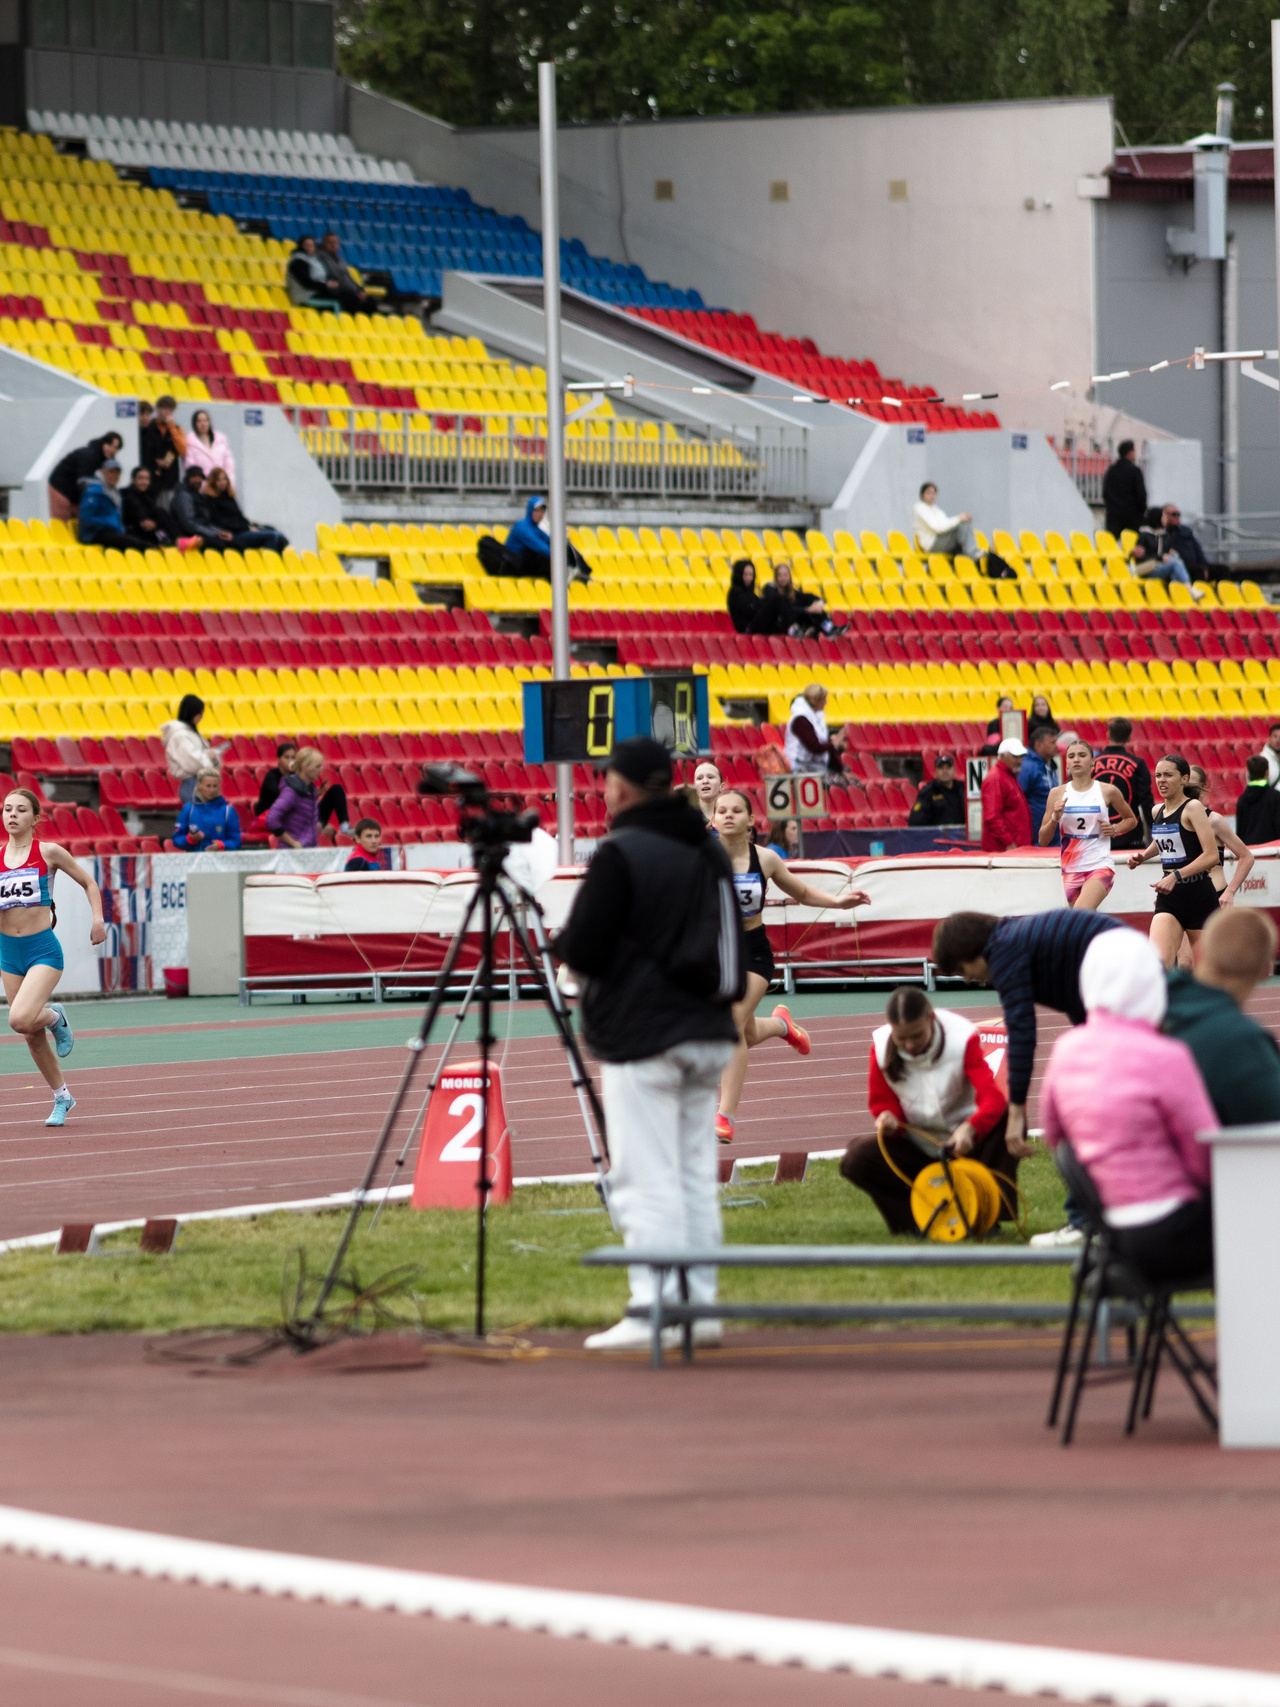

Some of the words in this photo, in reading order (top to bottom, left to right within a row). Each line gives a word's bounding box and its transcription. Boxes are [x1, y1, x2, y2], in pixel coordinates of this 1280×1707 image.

[587, 685, 614, 756] 0
[1092, 757, 1136, 779] ARIS
[1077, 817, 1086, 830] 2
[1156, 838, 1176, 853] 142
[0, 881, 34, 898] 445
[161, 882, 187, 909] ВСЕ
[980, 1033, 1009, 1044] ONDO
[439, 1093, 486, 1162] 2
